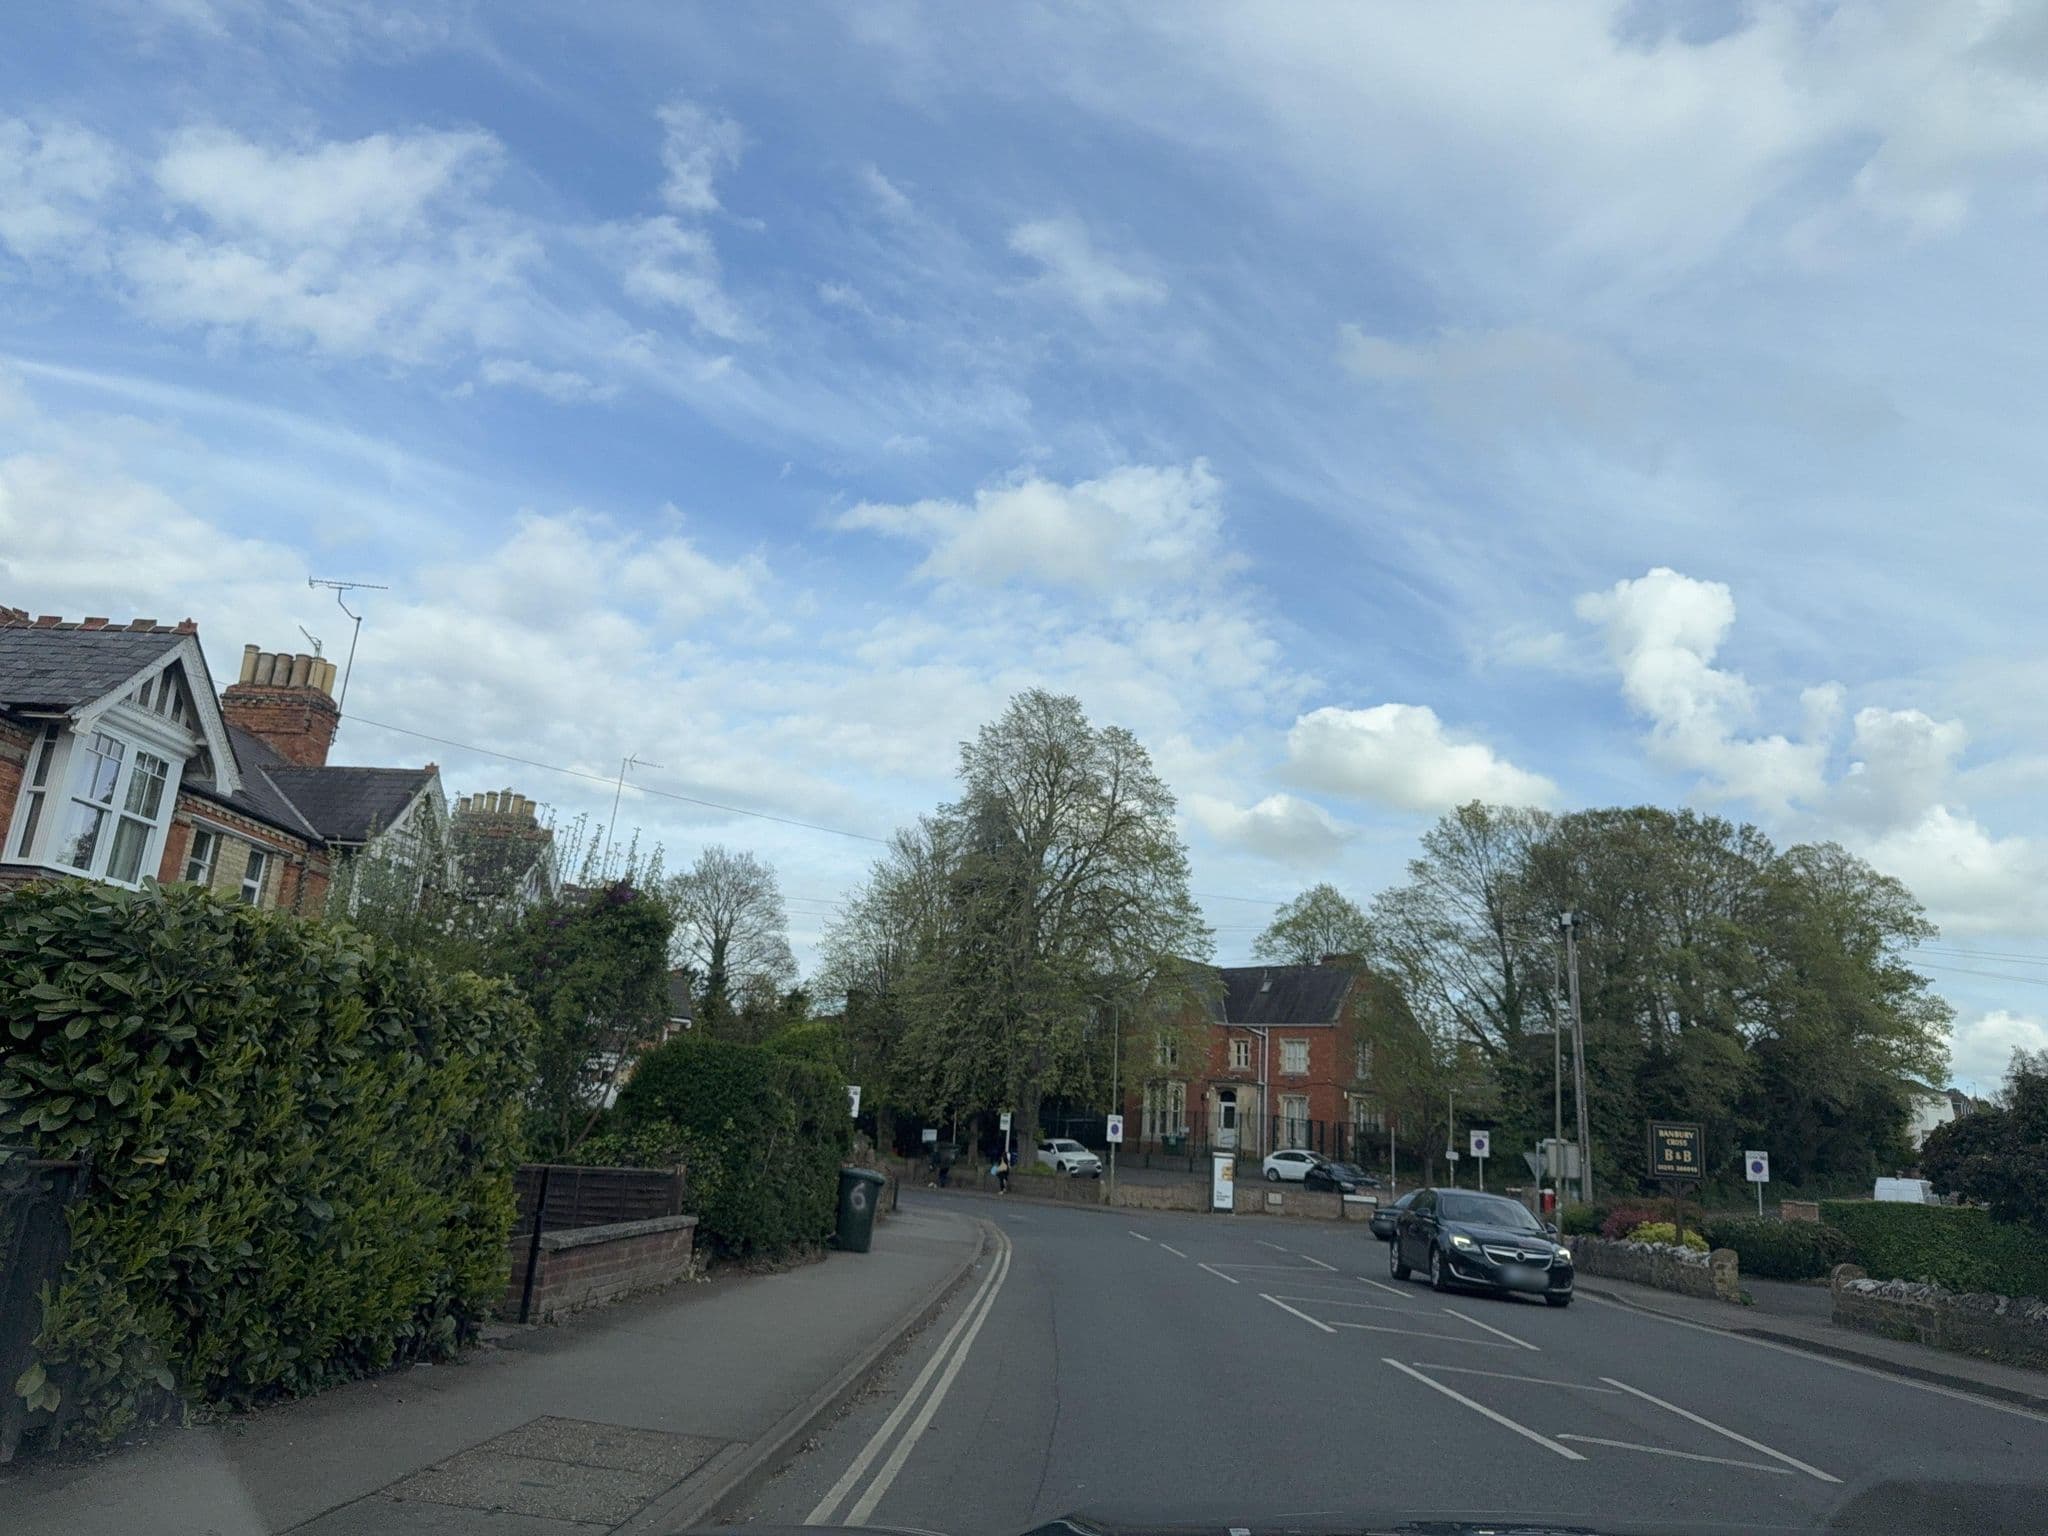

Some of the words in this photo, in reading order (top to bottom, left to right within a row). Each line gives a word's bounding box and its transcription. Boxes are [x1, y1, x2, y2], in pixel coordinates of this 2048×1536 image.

[1658, 1129, 1694, 1139] BANBURY
[1666, 1138, 1688, 1147] CROSS
[1664, 1149, 1673, 1161] B
[1674, 1151, 1682, 1160] &
[1683, 1150, 1692, 1162] B
[850, 1182, 865, 1210] 6
